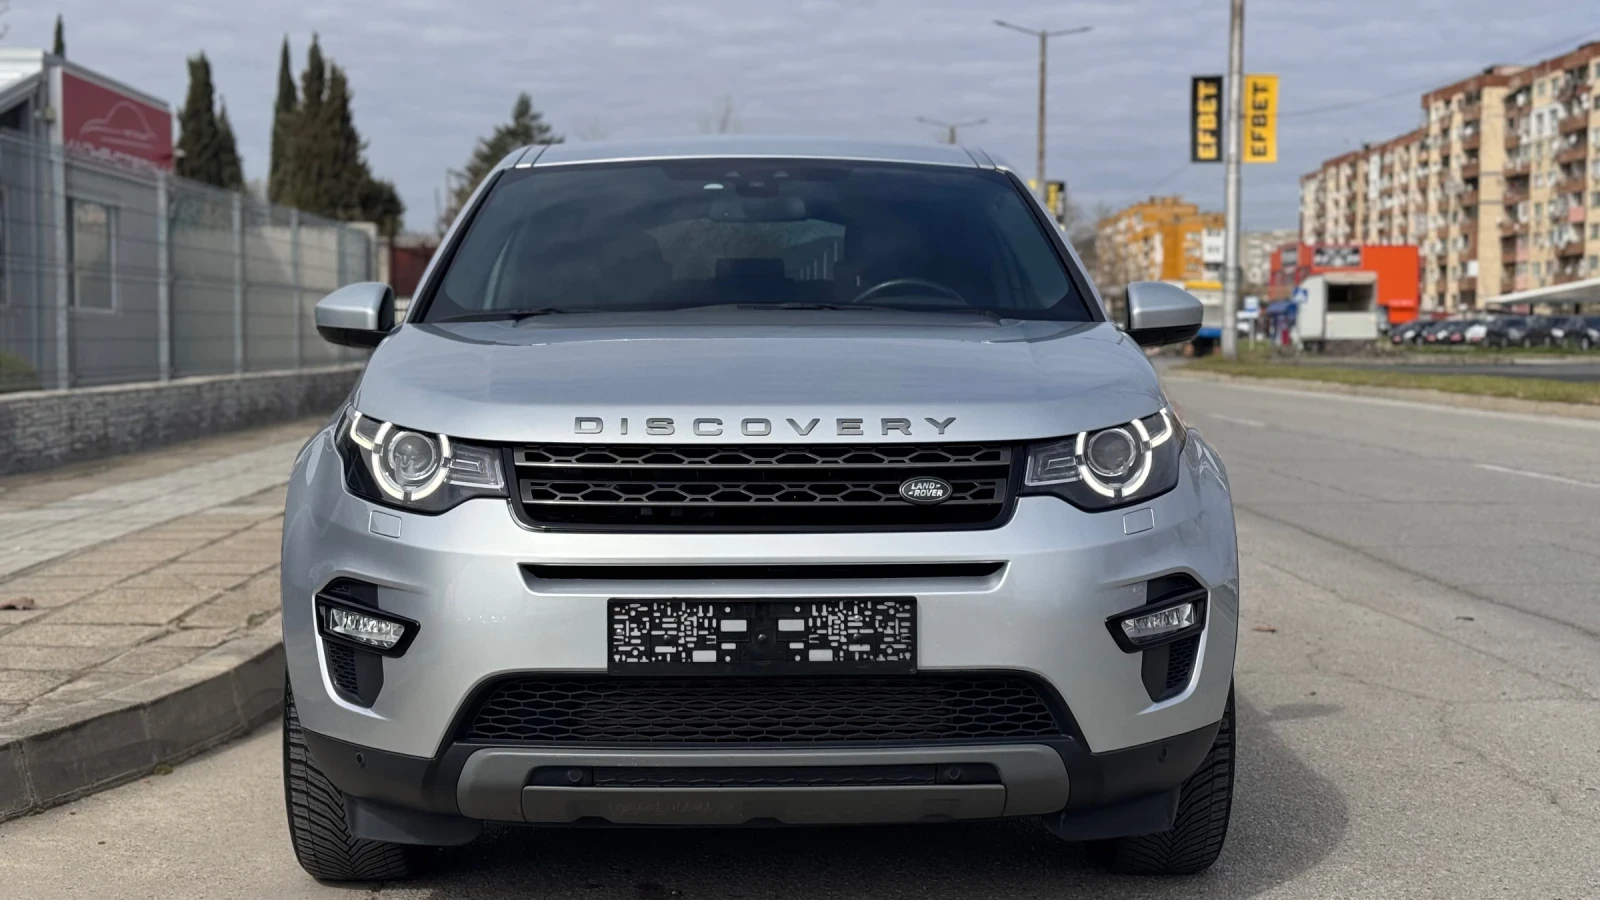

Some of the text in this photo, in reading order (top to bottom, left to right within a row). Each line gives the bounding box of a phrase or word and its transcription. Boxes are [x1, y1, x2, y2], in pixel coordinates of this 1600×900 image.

[1197, 81, 1218, 159] EFBET
[1251, 81, 1269, 157] EFBET
[574, 416, 957, 436] DISCOVERY
